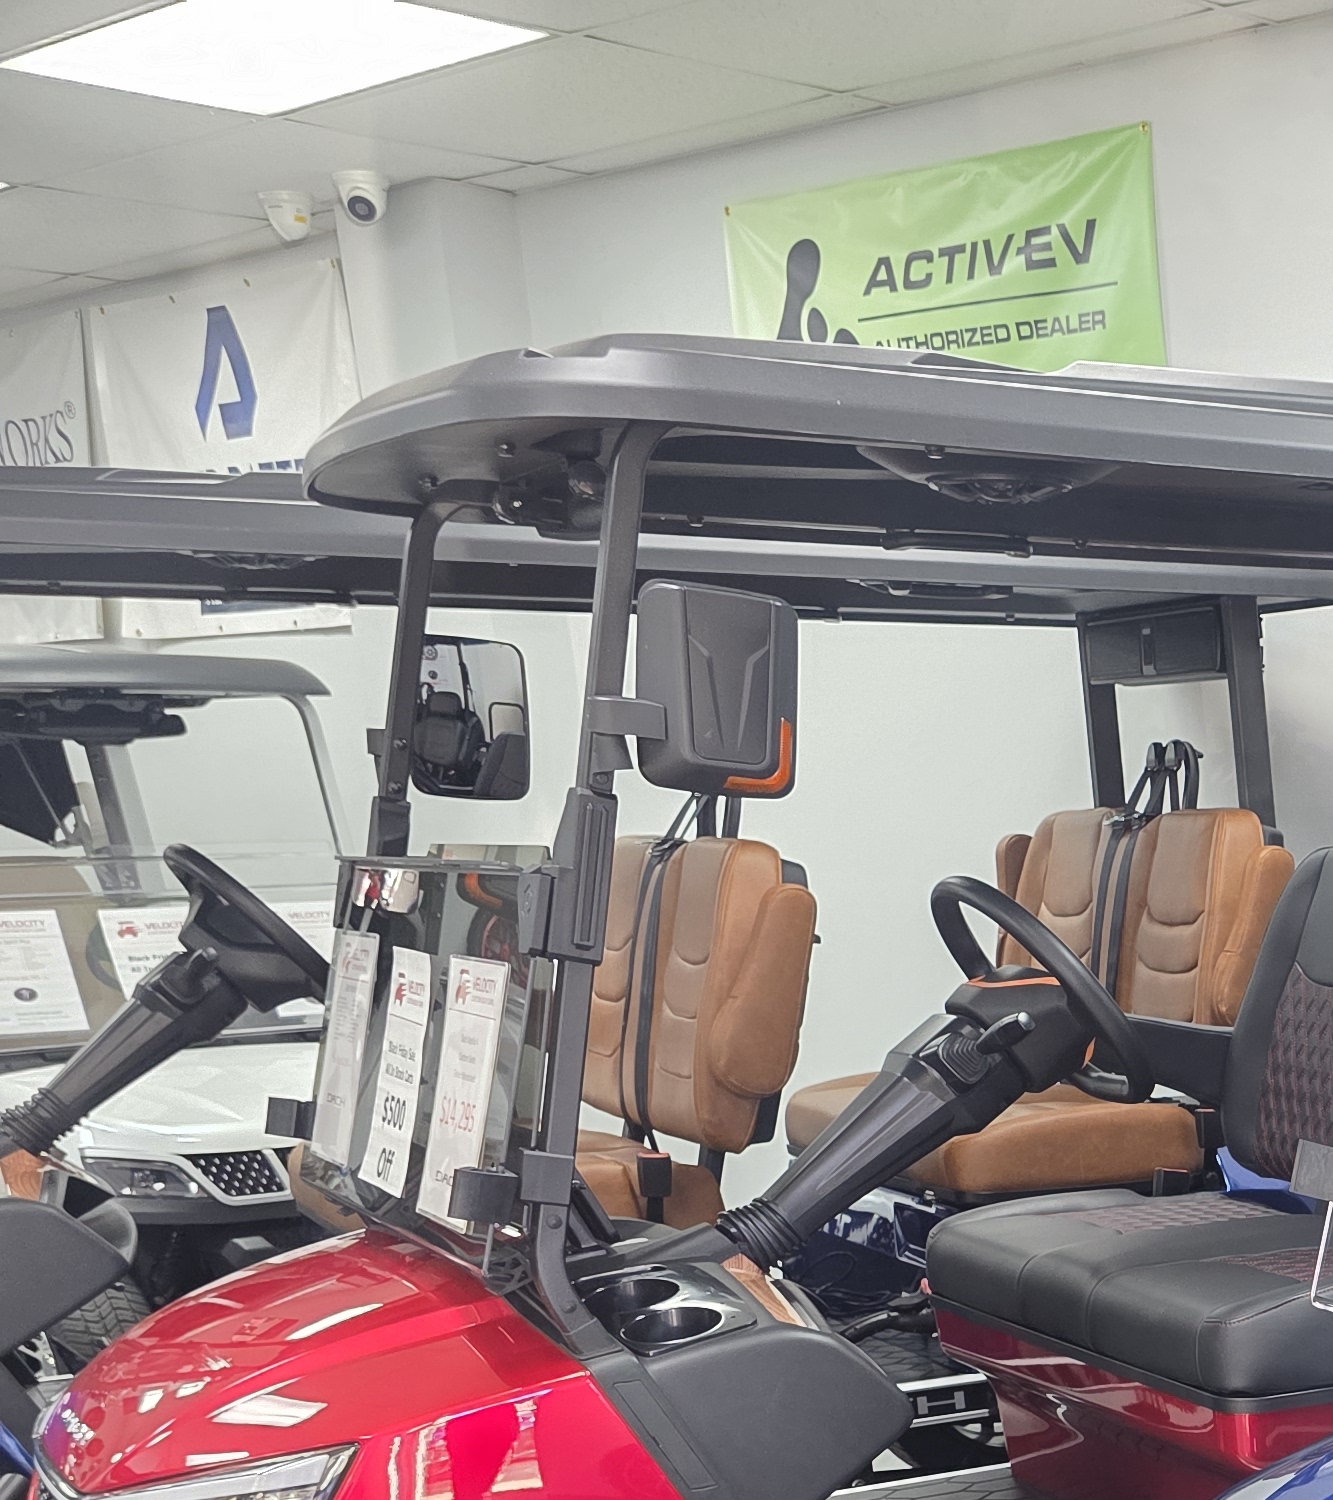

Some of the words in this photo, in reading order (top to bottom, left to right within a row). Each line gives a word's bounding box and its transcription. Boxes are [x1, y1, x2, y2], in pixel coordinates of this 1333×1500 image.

[1014, 310, 1106, 341] DEALER
[145, 921, 183, 930] VELOCIT
[382, 1090, 407, 1131] $500
[439, 1094, 477, 1134] $14,295
[377, 1147, 395, 1182] Off
[435, 1170, 453, 1187] DAC
